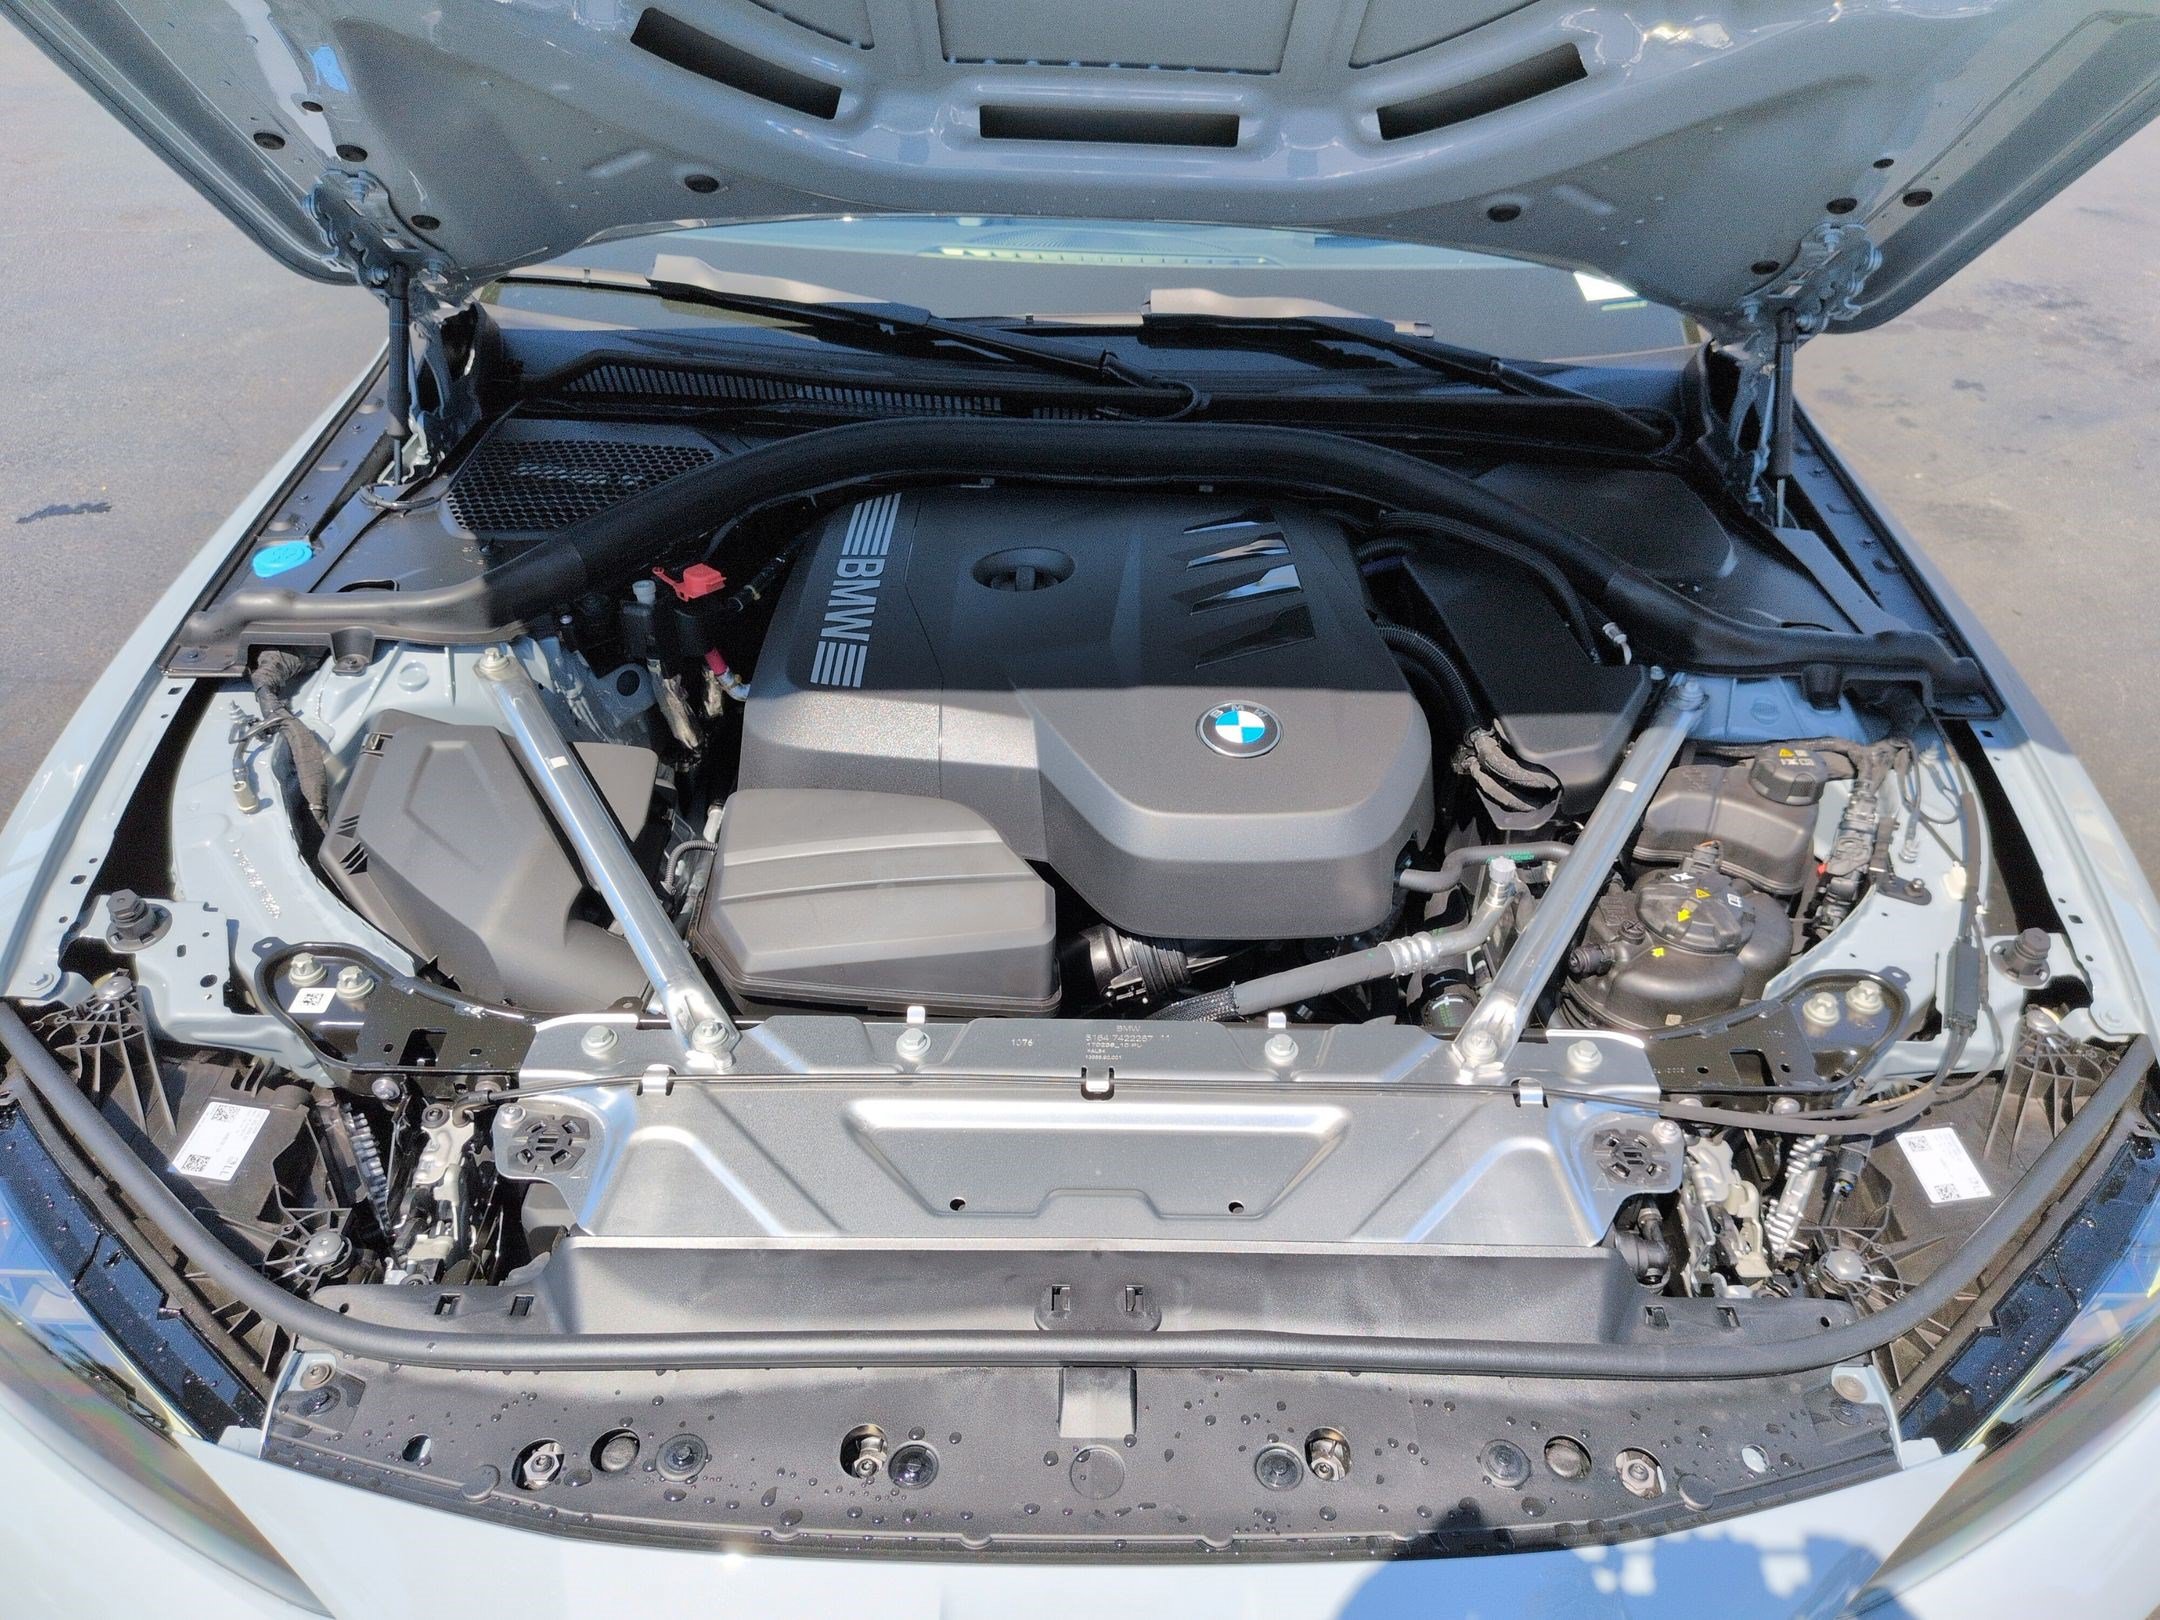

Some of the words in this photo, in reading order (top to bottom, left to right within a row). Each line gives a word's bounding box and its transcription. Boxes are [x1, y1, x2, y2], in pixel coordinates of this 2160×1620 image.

[820, 558, 886, 642] BMW
[1209, 703, 1269, 718] BMW
[1116, 1024, 1141, 1033] BMW
